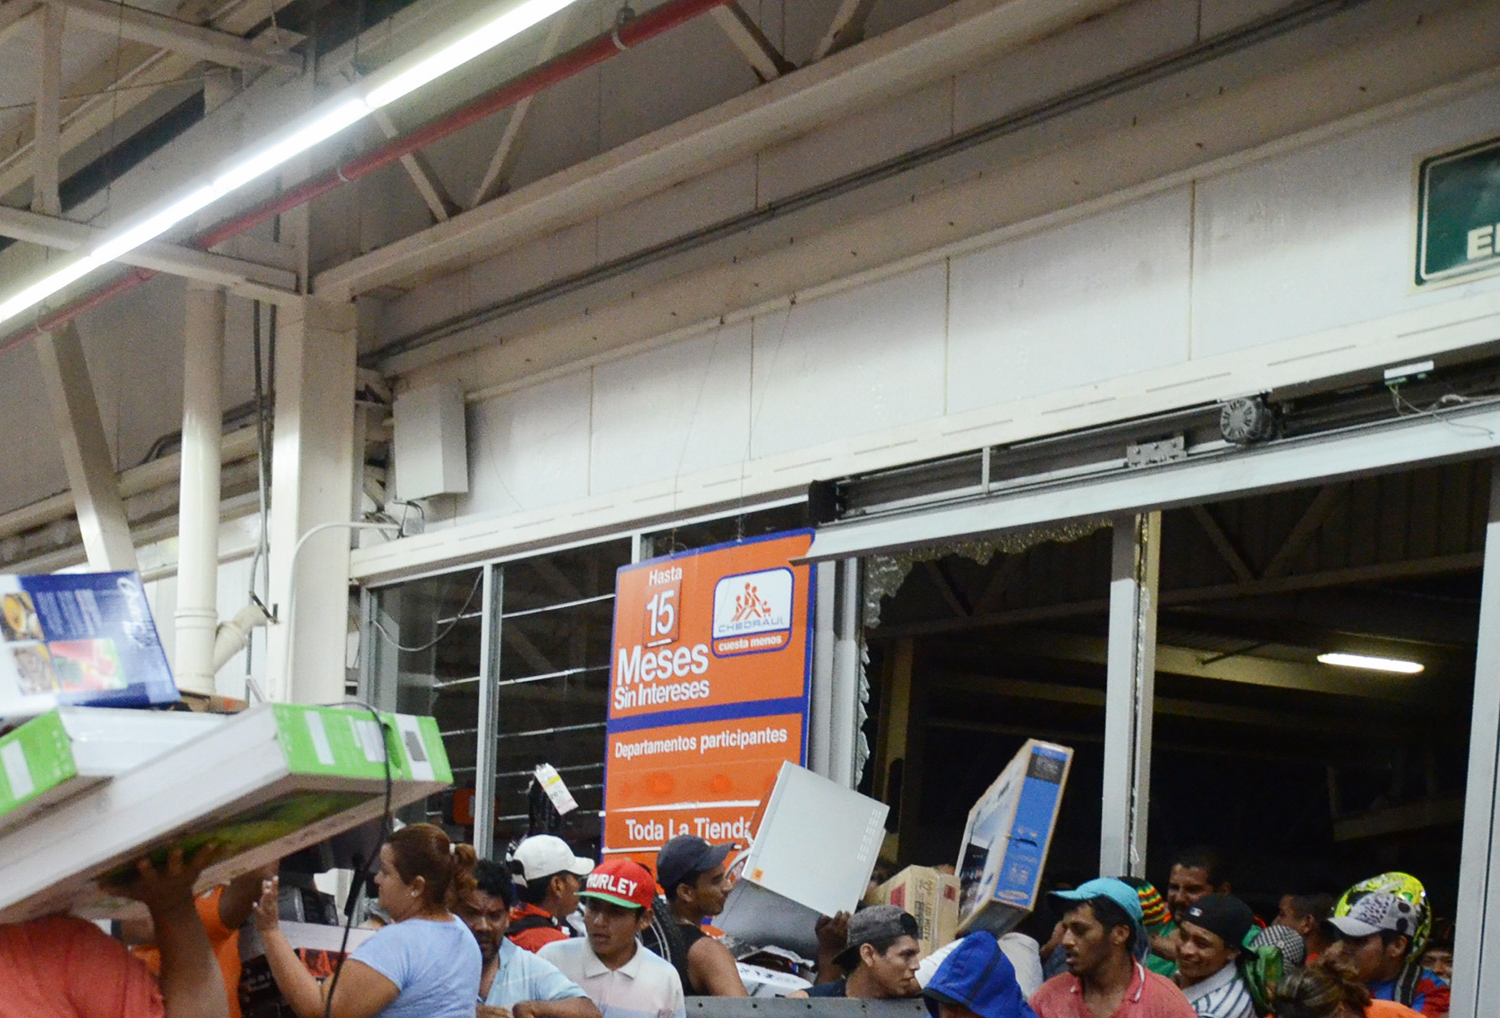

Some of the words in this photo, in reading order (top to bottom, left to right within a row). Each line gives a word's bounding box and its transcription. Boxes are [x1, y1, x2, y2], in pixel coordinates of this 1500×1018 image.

[1466, 222, 1500, 261] E
[648, 565, 683, 586] Hasta
[646, 589, 675, 637] 15
[717, 617, 785, 633] CHEDRAUI
[718, 638, 749, 652] cuesta
[750, 634, 782, 649] menos
[617, 643, 710, 686] Meses
[614, 686, 636, 710] Sin
[638, 679, 710, 708] Intereses
[615, 735, 697, 760] Departamentos
[700, 727, 788, 754] participantes
[625, 819, 664, 840] Toda
[668, 818, 689, 839] La
[586, 872, 637, 898] HURLEY
